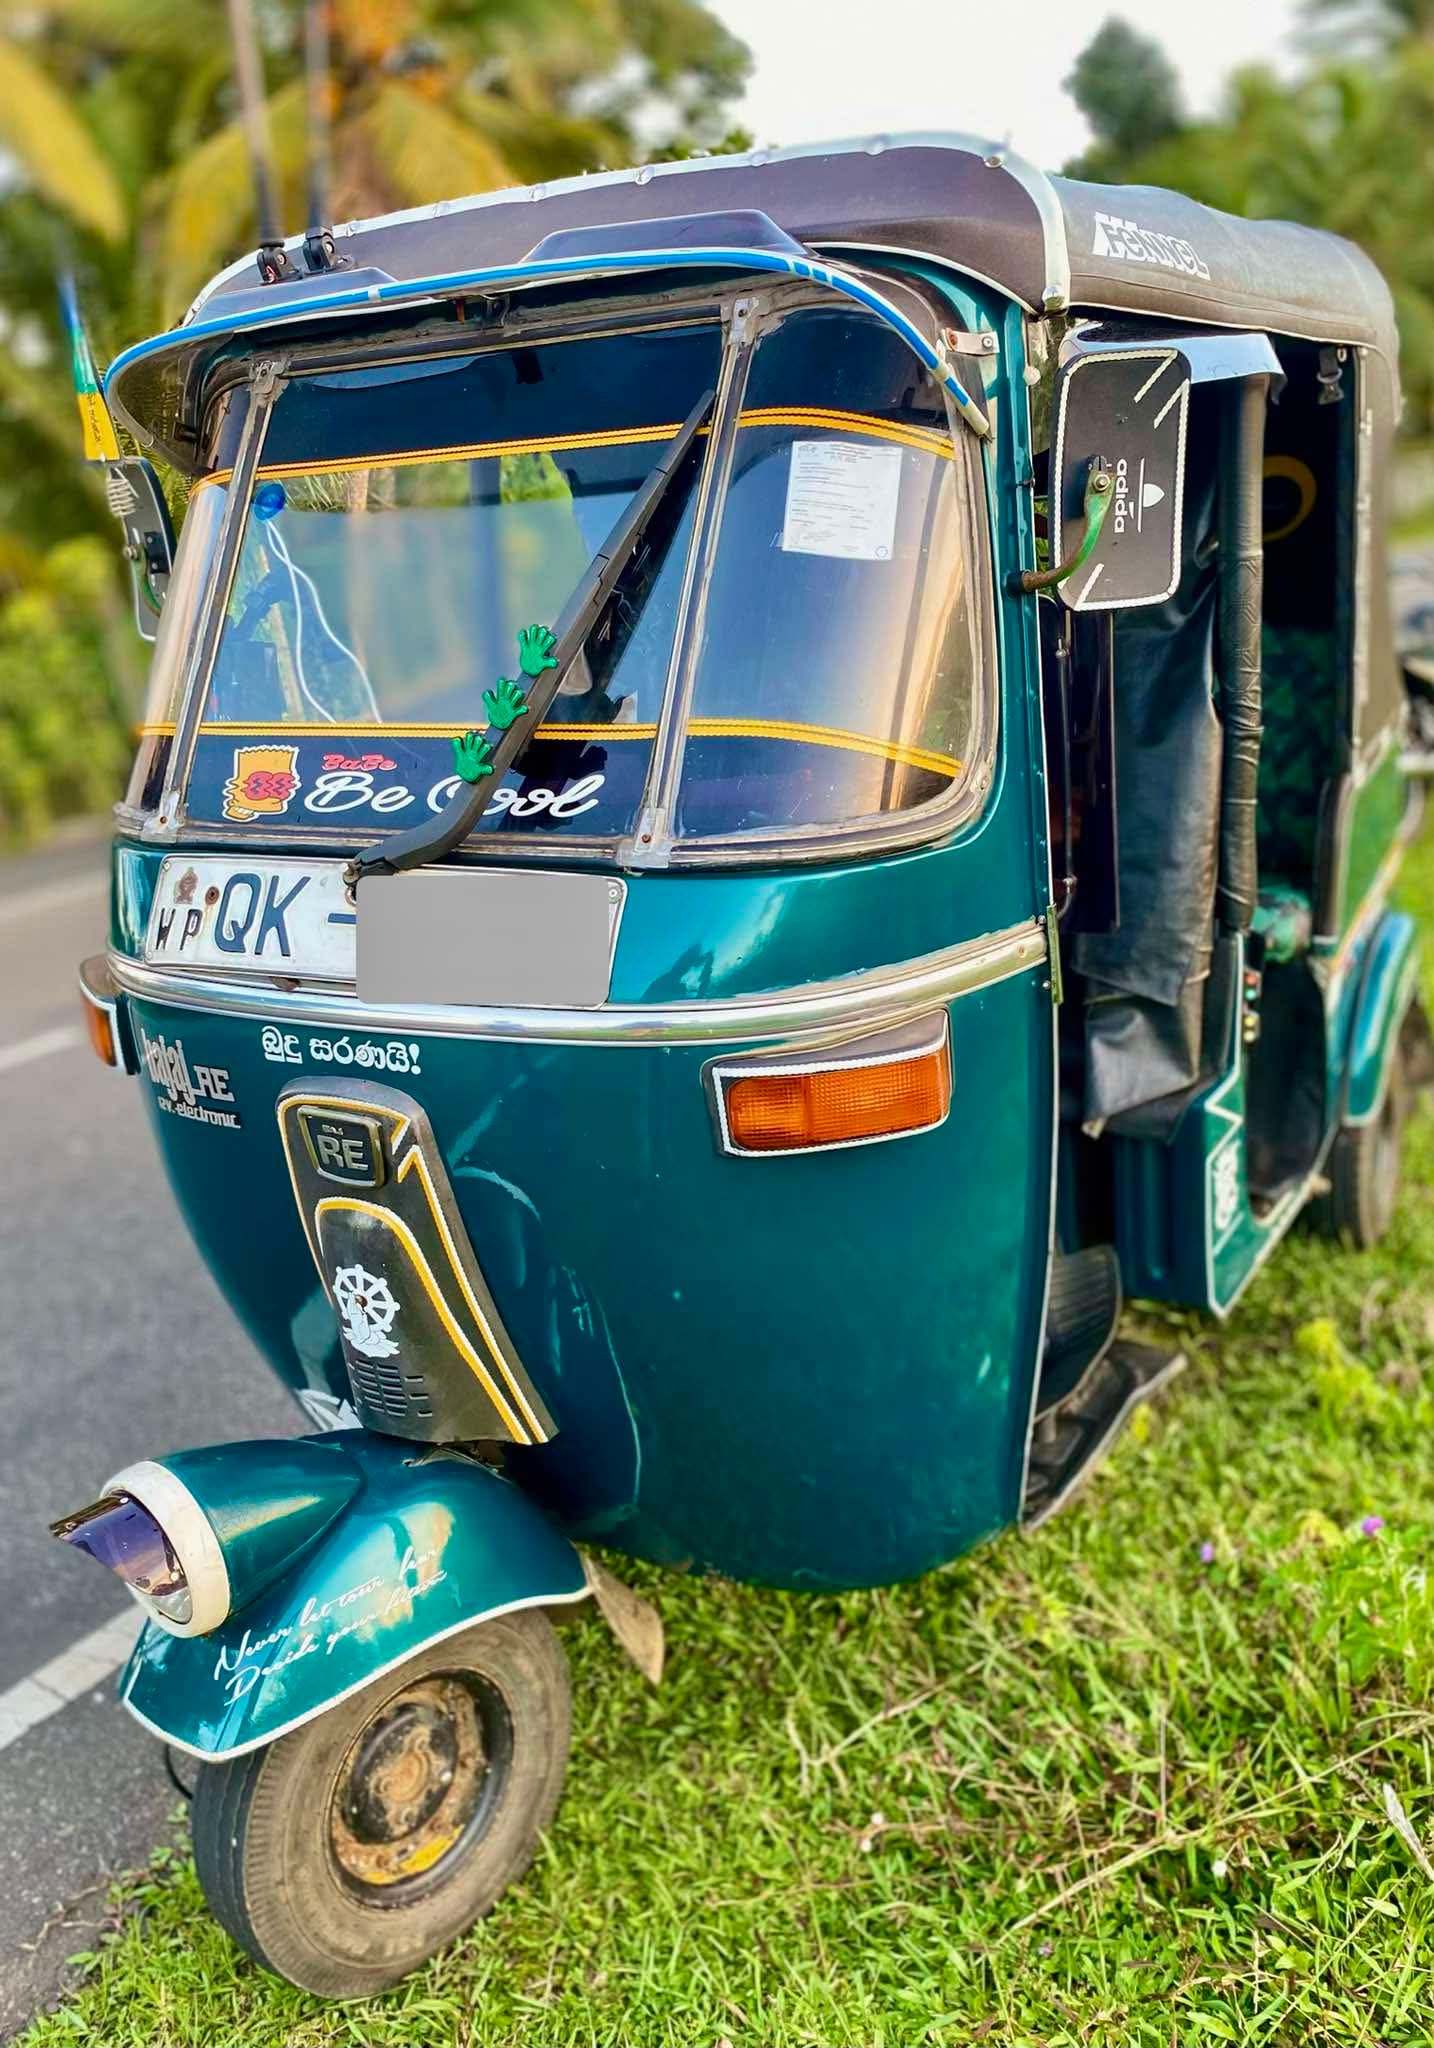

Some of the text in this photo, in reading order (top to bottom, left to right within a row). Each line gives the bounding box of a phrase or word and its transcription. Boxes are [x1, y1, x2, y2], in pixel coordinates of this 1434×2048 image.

[303, 770, 416, 814] Be
[154, 907, 204, 952] WP
[214, 872, 312, 958] QK
[261, 1024, 304, 1065] බුදු
[316, 1133, 370, 1172] RE
[213, 1625, 294, 1681] Never
